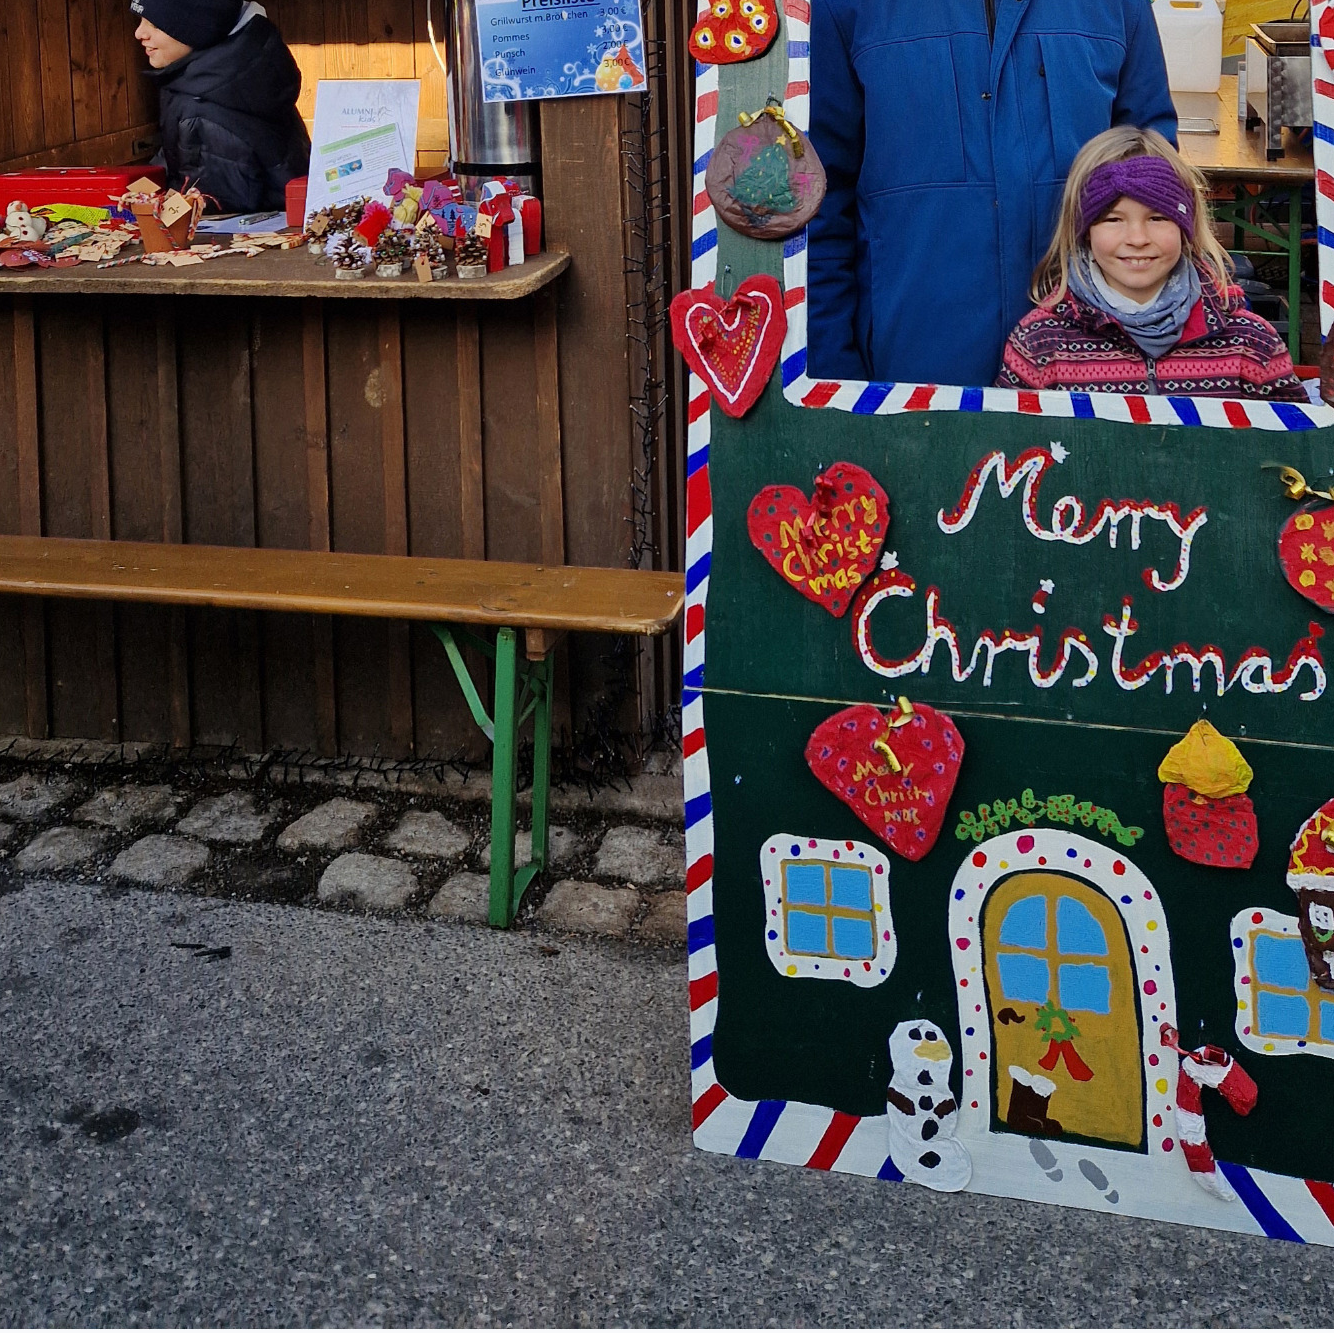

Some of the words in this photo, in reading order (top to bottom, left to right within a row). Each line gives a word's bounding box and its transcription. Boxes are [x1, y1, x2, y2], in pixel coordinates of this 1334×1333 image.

[490, 14, 533, 27] Grillwurst
[599, 7, 619, 18] 3,00
[620, 6, 627, 15] €
[492, 32, 530, 44] Pommes
[602, 23, 621, 34] 3,00
[622, 23, 629, 32] €
[494, 48, 526, 59] Punsch
[603, 40, 622, 50] 2,00
[623, 39, 629, 47] €
[341, 107, 374, 115] ALUMNI
[937, 443, 1208, 591] Merry
[808, 563, 862, 595] mas
[852, 556, 1327, 702] Christmas
